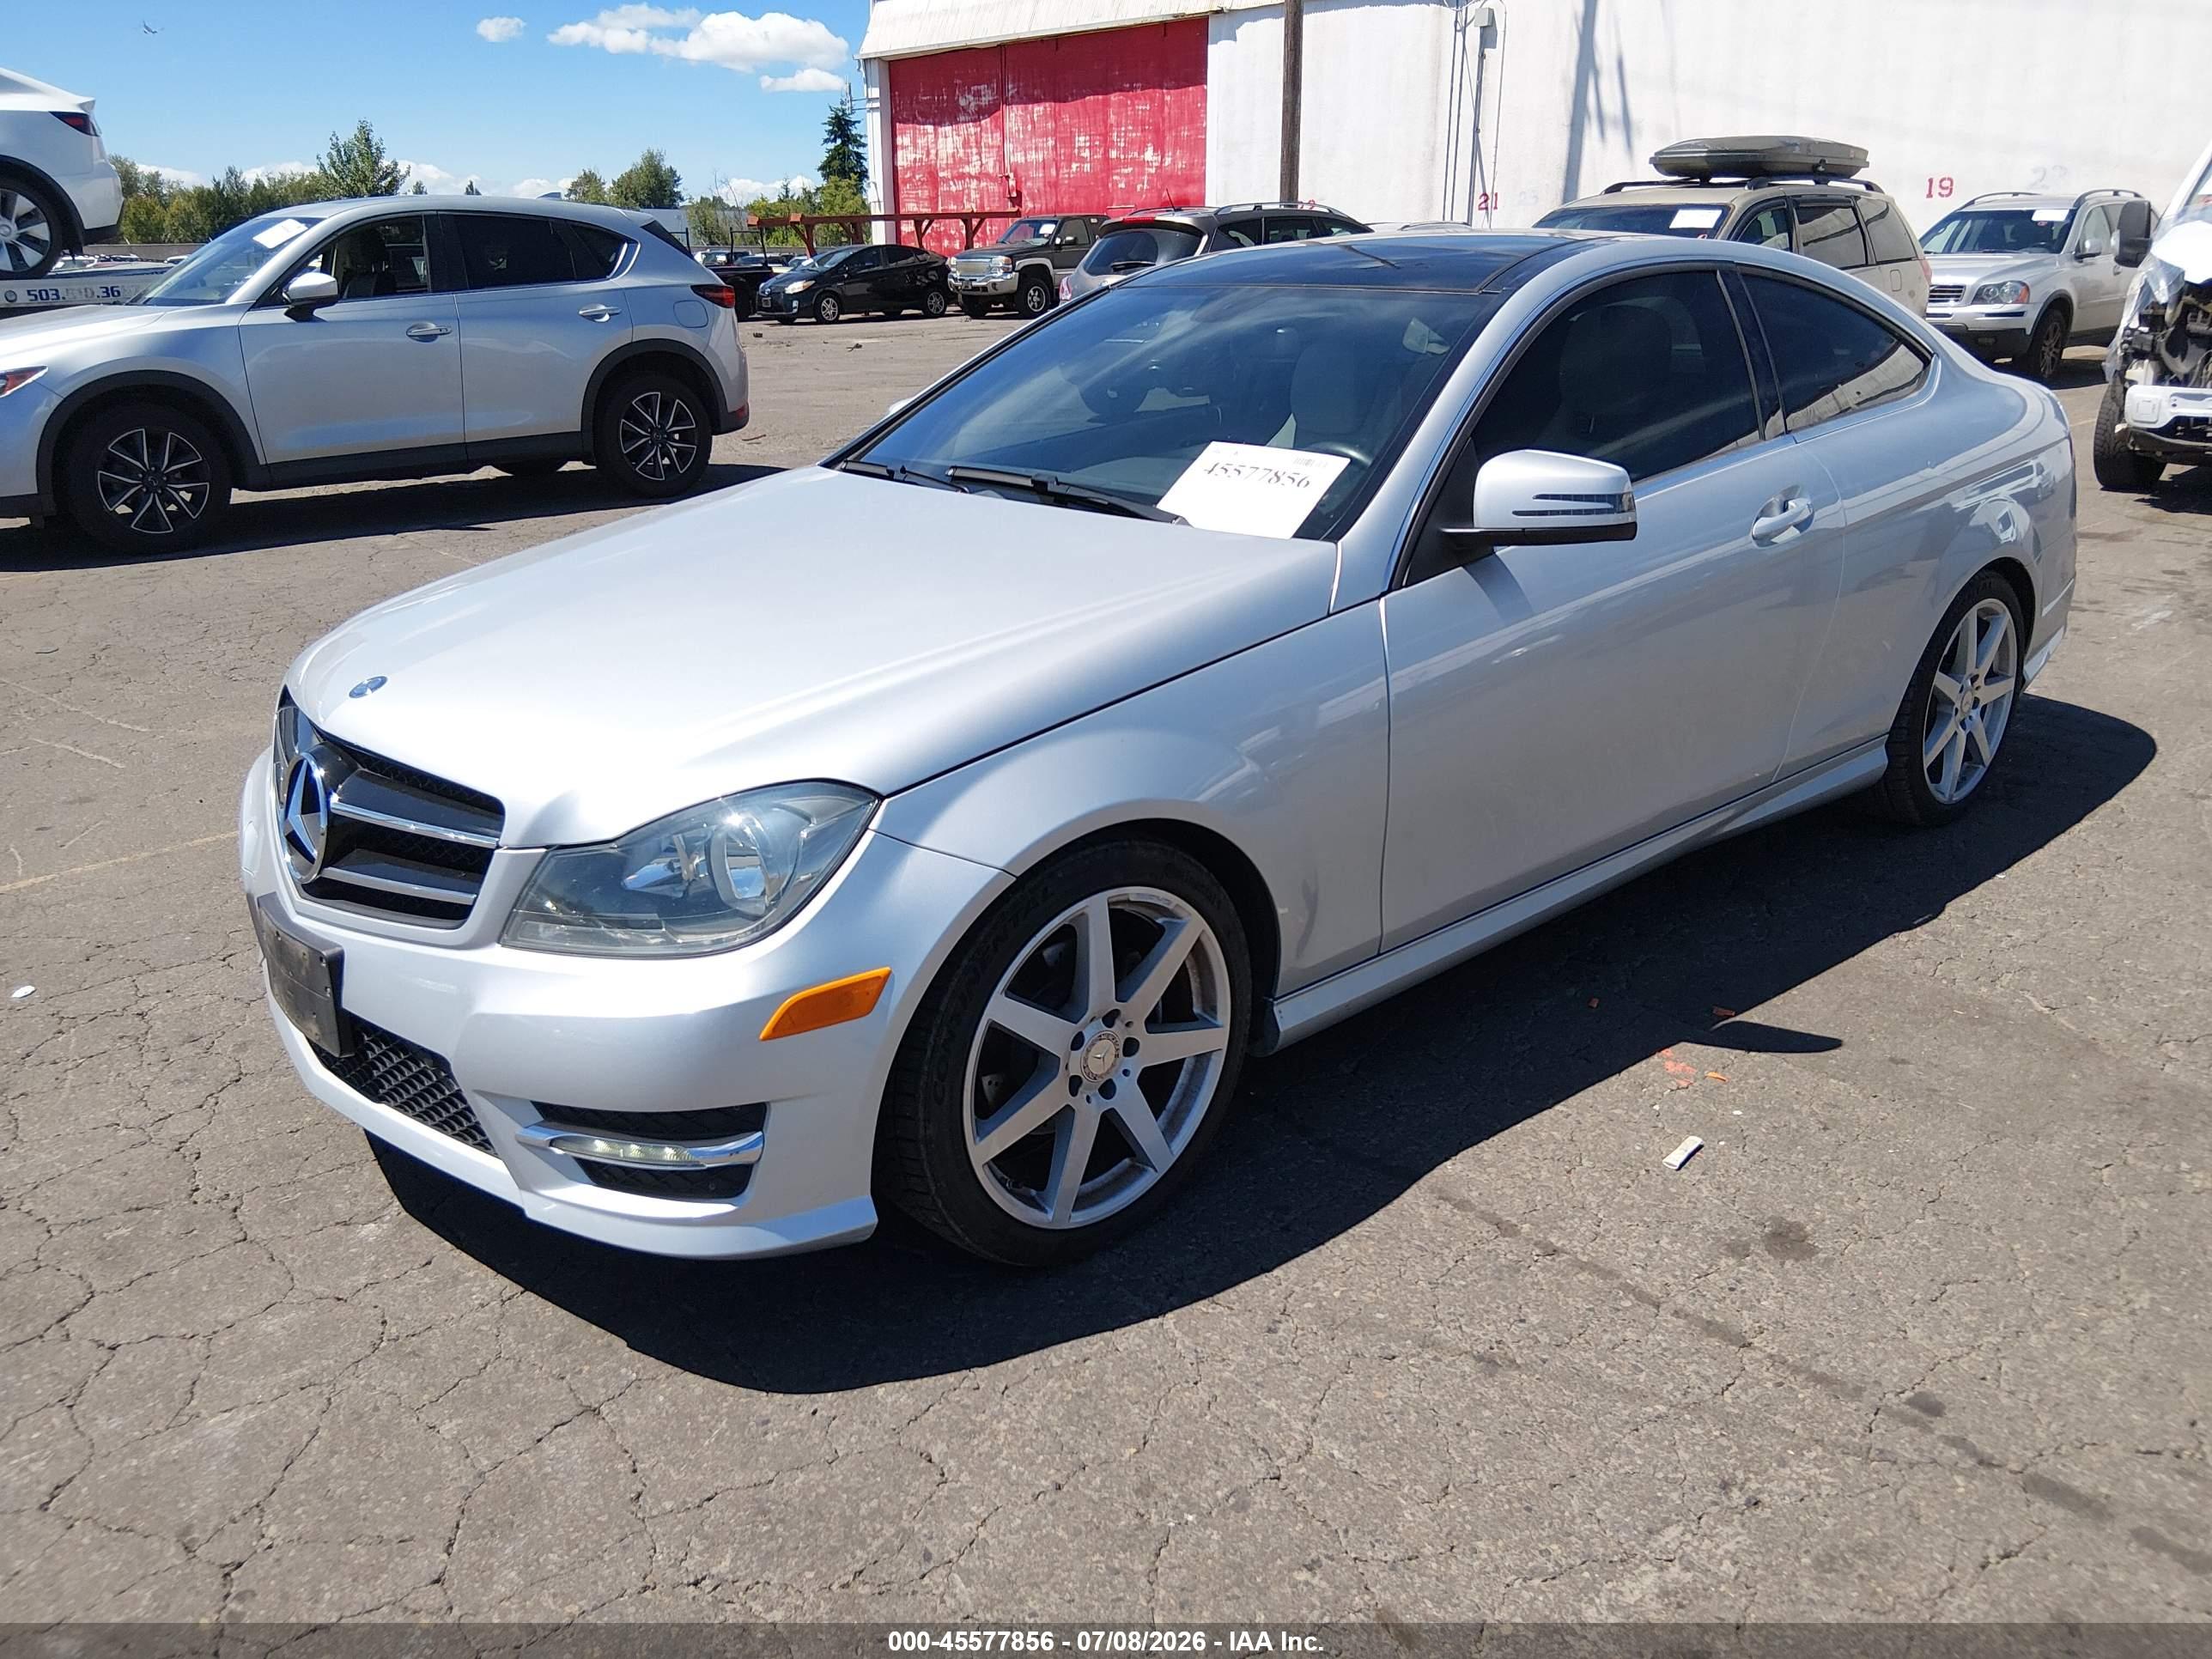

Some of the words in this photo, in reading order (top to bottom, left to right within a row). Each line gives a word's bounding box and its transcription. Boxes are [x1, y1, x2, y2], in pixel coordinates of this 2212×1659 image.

[1926, 177, 1954, 198] 19
[1478, 191, 1498, 210] 21
[1204, 462, 1310, 489] 45577856
